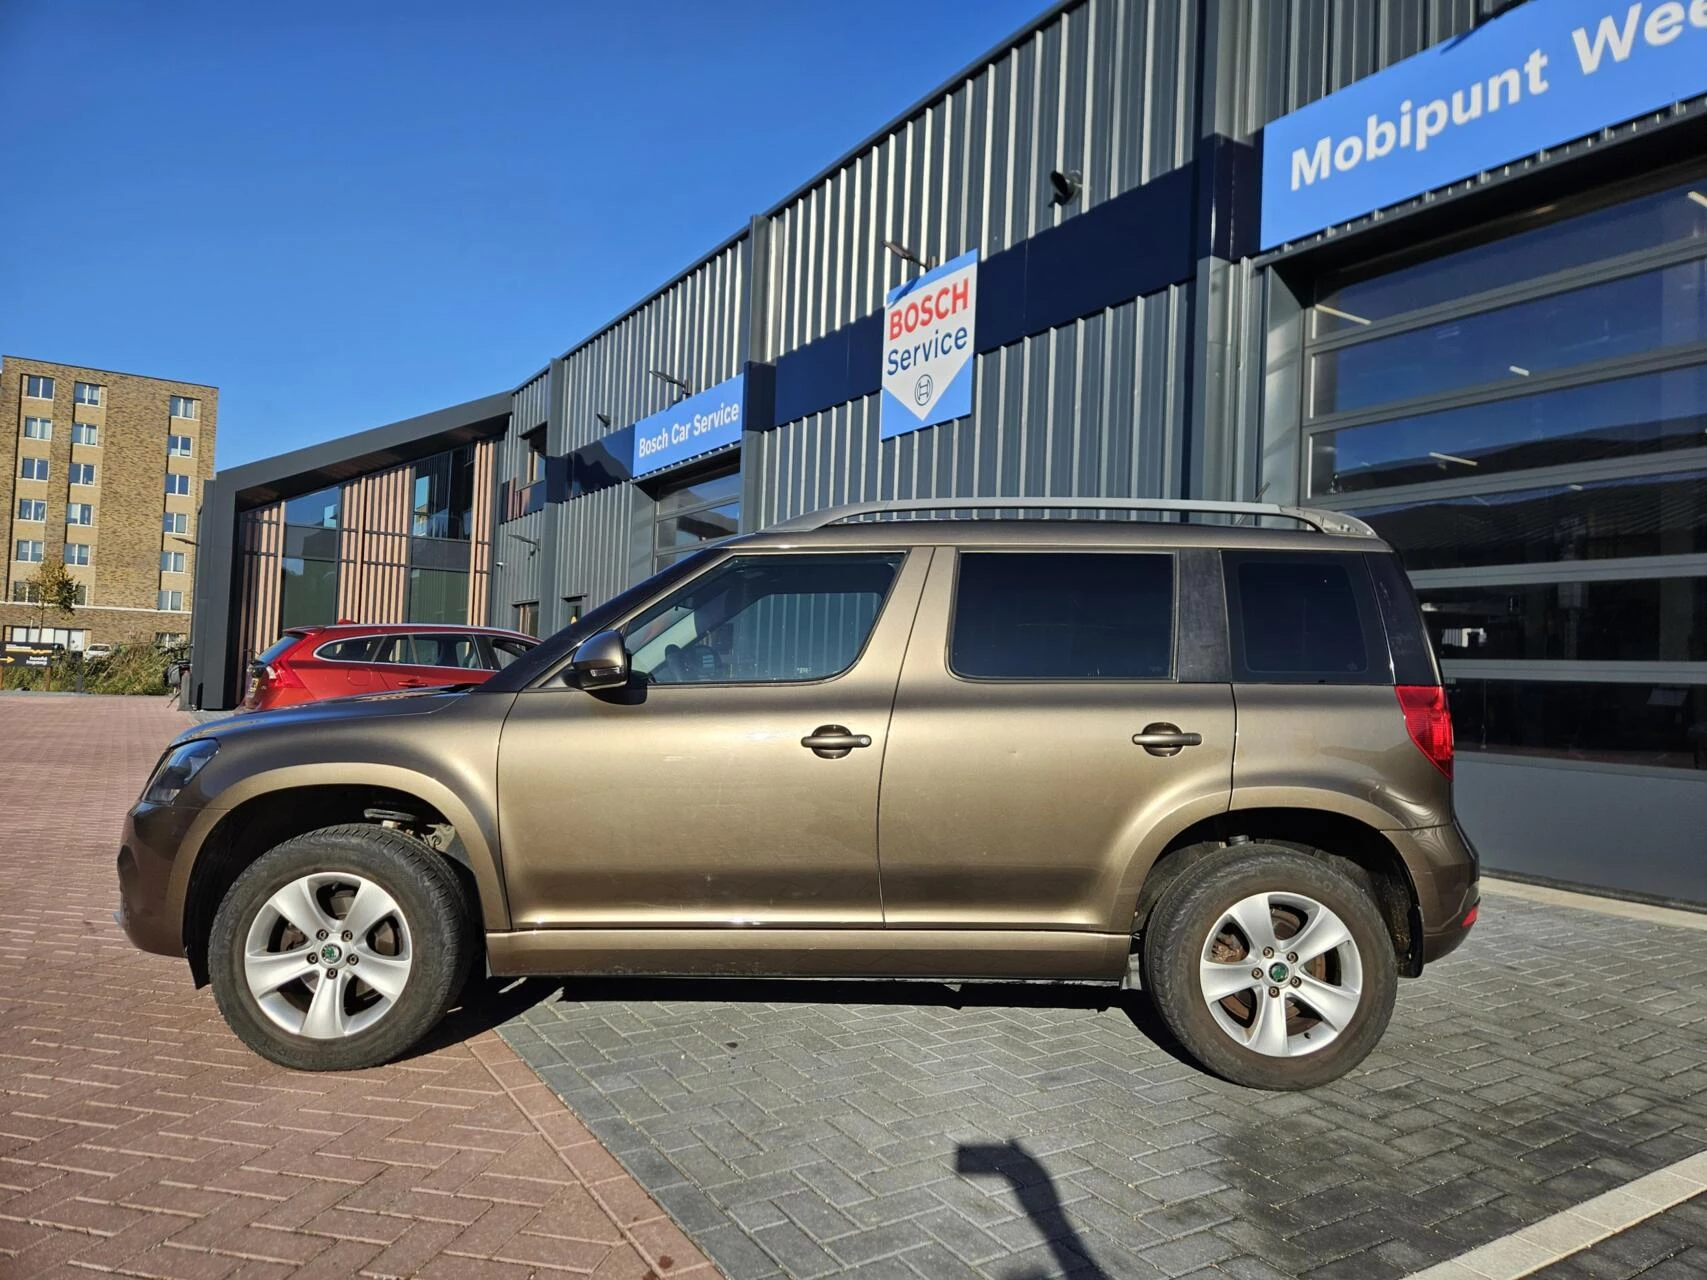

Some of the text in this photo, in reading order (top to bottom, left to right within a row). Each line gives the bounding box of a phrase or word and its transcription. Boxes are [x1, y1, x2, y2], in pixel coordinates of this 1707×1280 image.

[1290, 48, 1549, 191] Mobipunt
[889, 277, 969, 341] BOSCH
[887, 327, 968, 375] Service
[639, 402, 739, 457] Bosch Car Service
